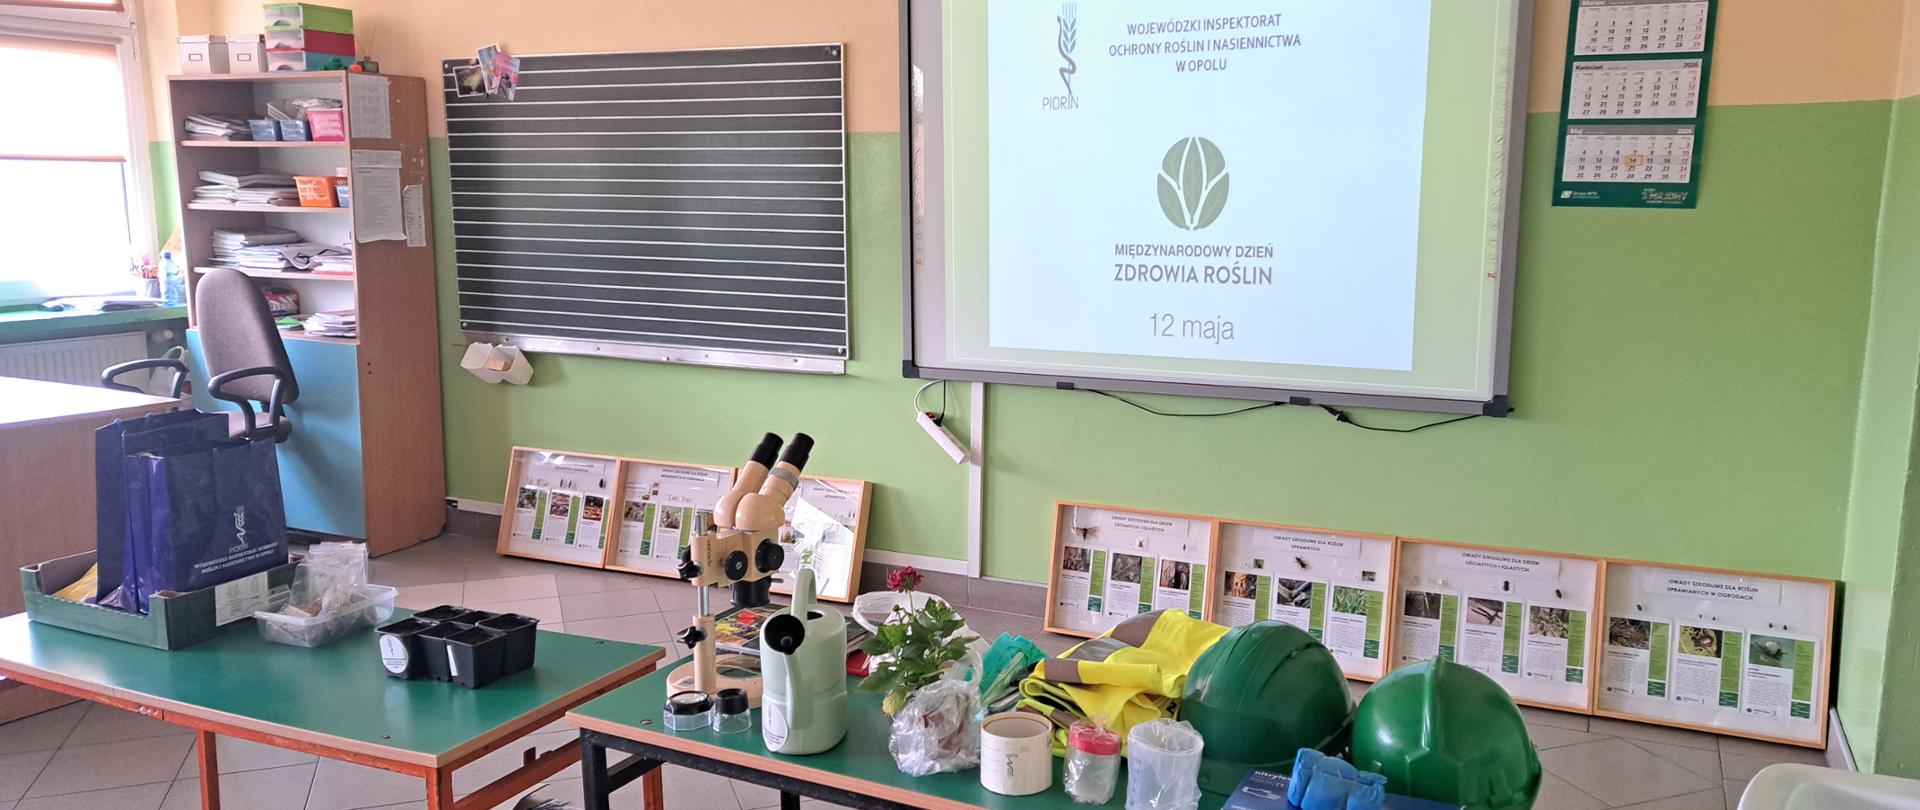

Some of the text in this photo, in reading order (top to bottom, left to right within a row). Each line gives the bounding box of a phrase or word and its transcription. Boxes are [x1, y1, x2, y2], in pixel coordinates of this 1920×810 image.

[1127, 14, 1282, 35] WOJEWÓDZKI INSPEKTORAT
[1109, 34, 1301, 56] OCHRONY ROŚLIN I NASIENNICTWA
[1176, 59, 1227, 72] W OPOLU
[1042, 96, 1079, 110] PIORIN
[1115, 243, 1273, 259] MIĘDZYNARODOWY DZIEŃ
[1114, 262, 1272, 284] ZDROWIA ROŚLIN
[1150, 313, 1234, 344] 12 maja
